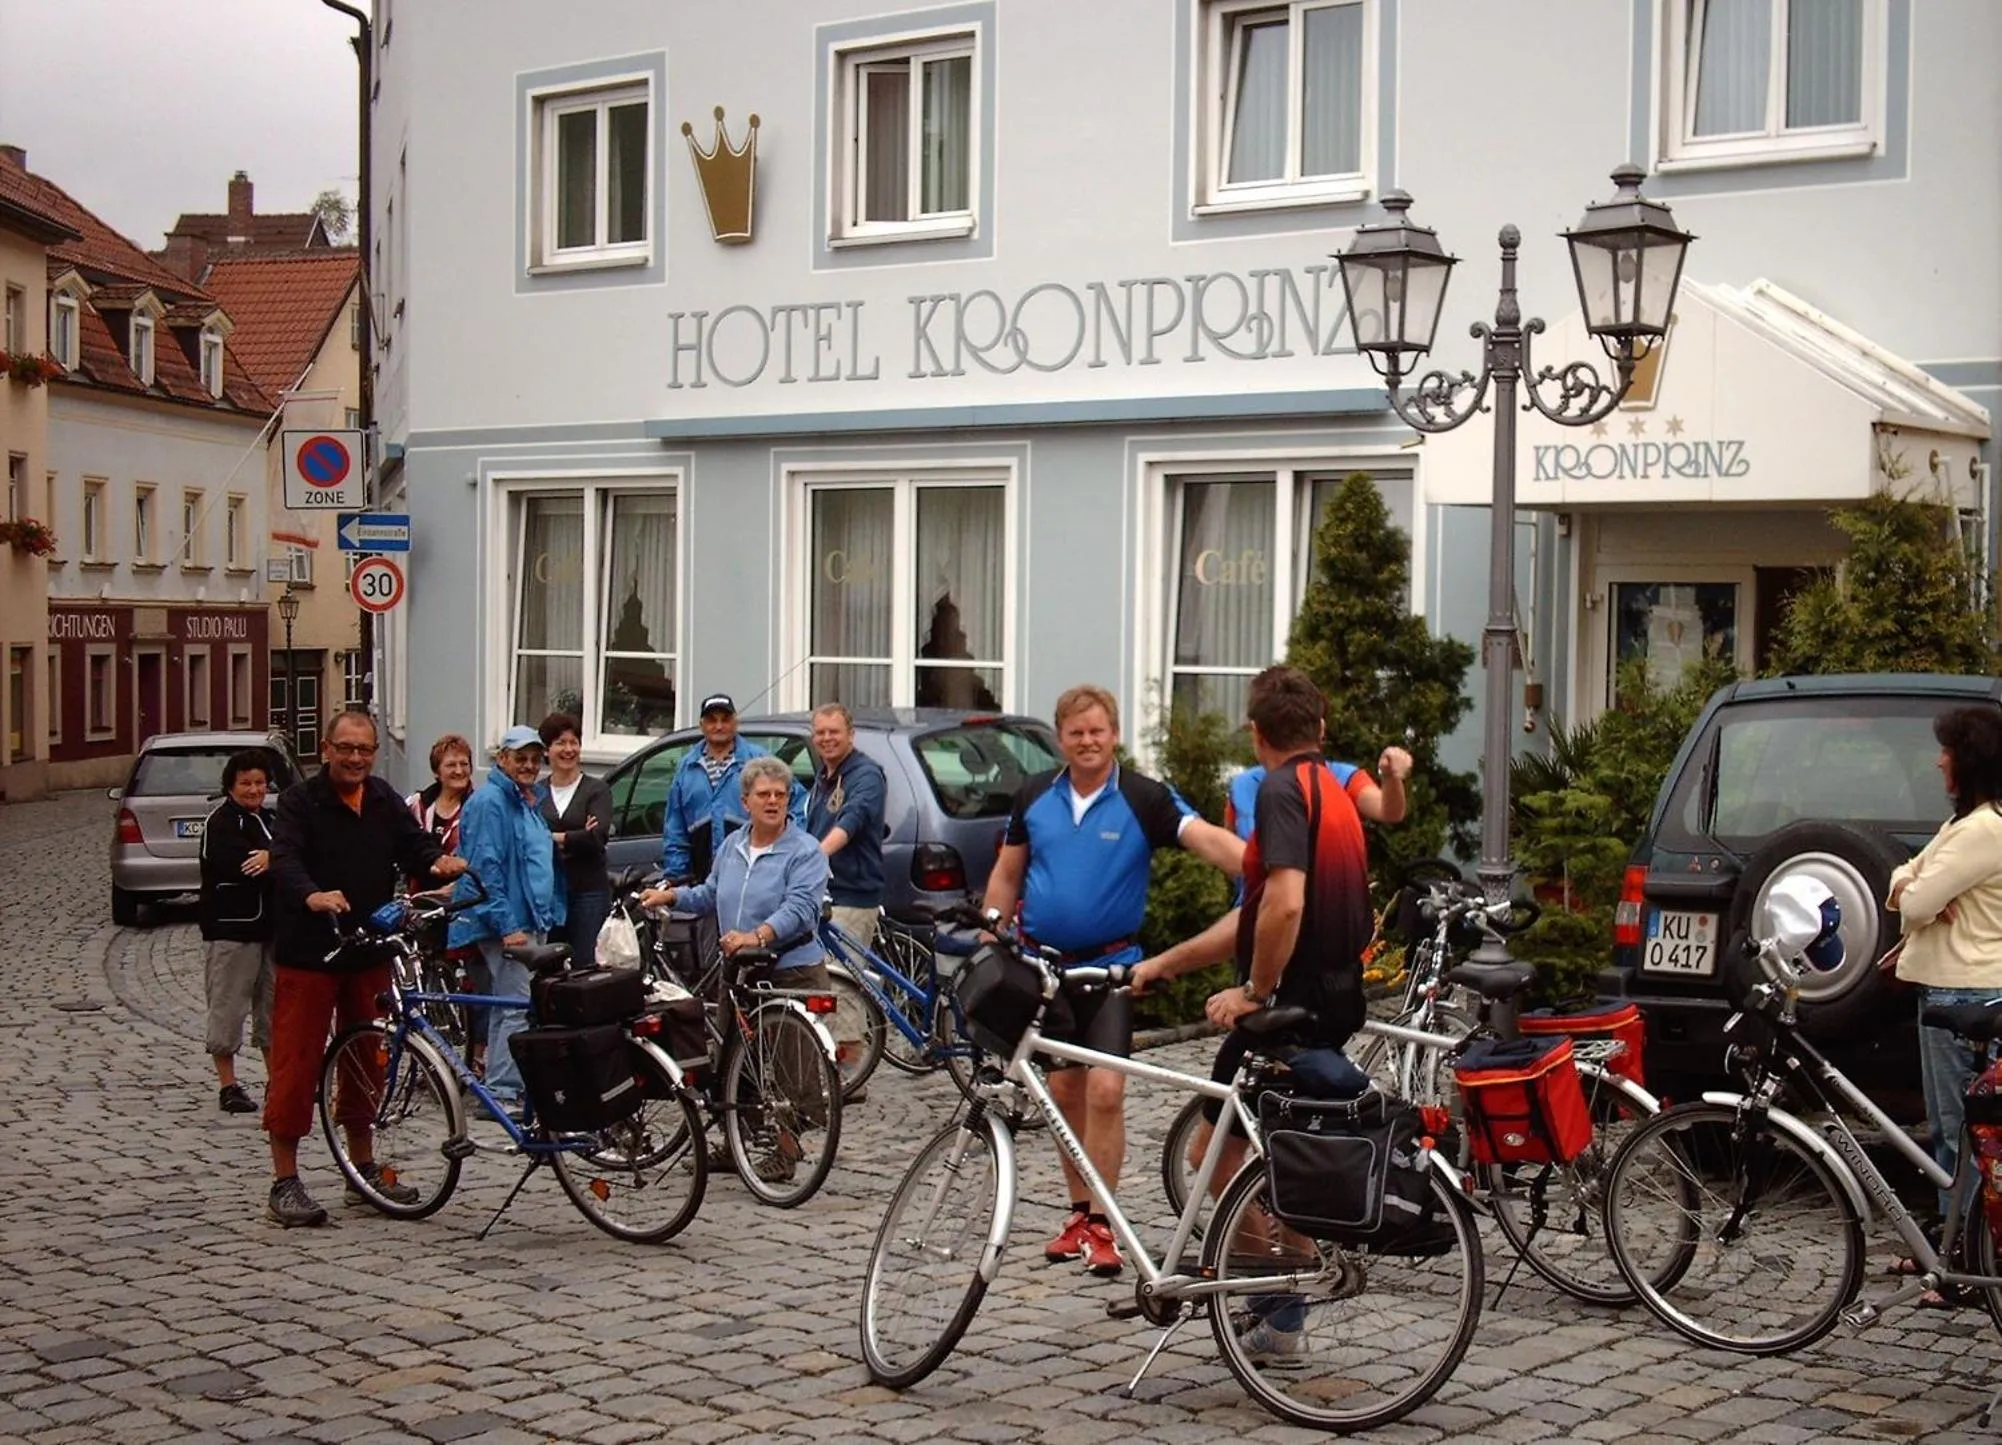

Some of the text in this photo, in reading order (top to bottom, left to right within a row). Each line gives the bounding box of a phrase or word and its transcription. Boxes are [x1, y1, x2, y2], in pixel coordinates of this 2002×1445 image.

[667, 264, 1383, 388] HOTEL KRONPRINZ
[1533, 441, 1750, 481] KRONPRINZ
[305, 491, 345, 504] ZONE
[1194, 549, 1267, 586] Café
[362, 573, 393, 597] 30
[186, 616, 221, 638] STUDIO
[1662, 916, 1691, 940] KU
[1668, 944, 1708, 969] 417
